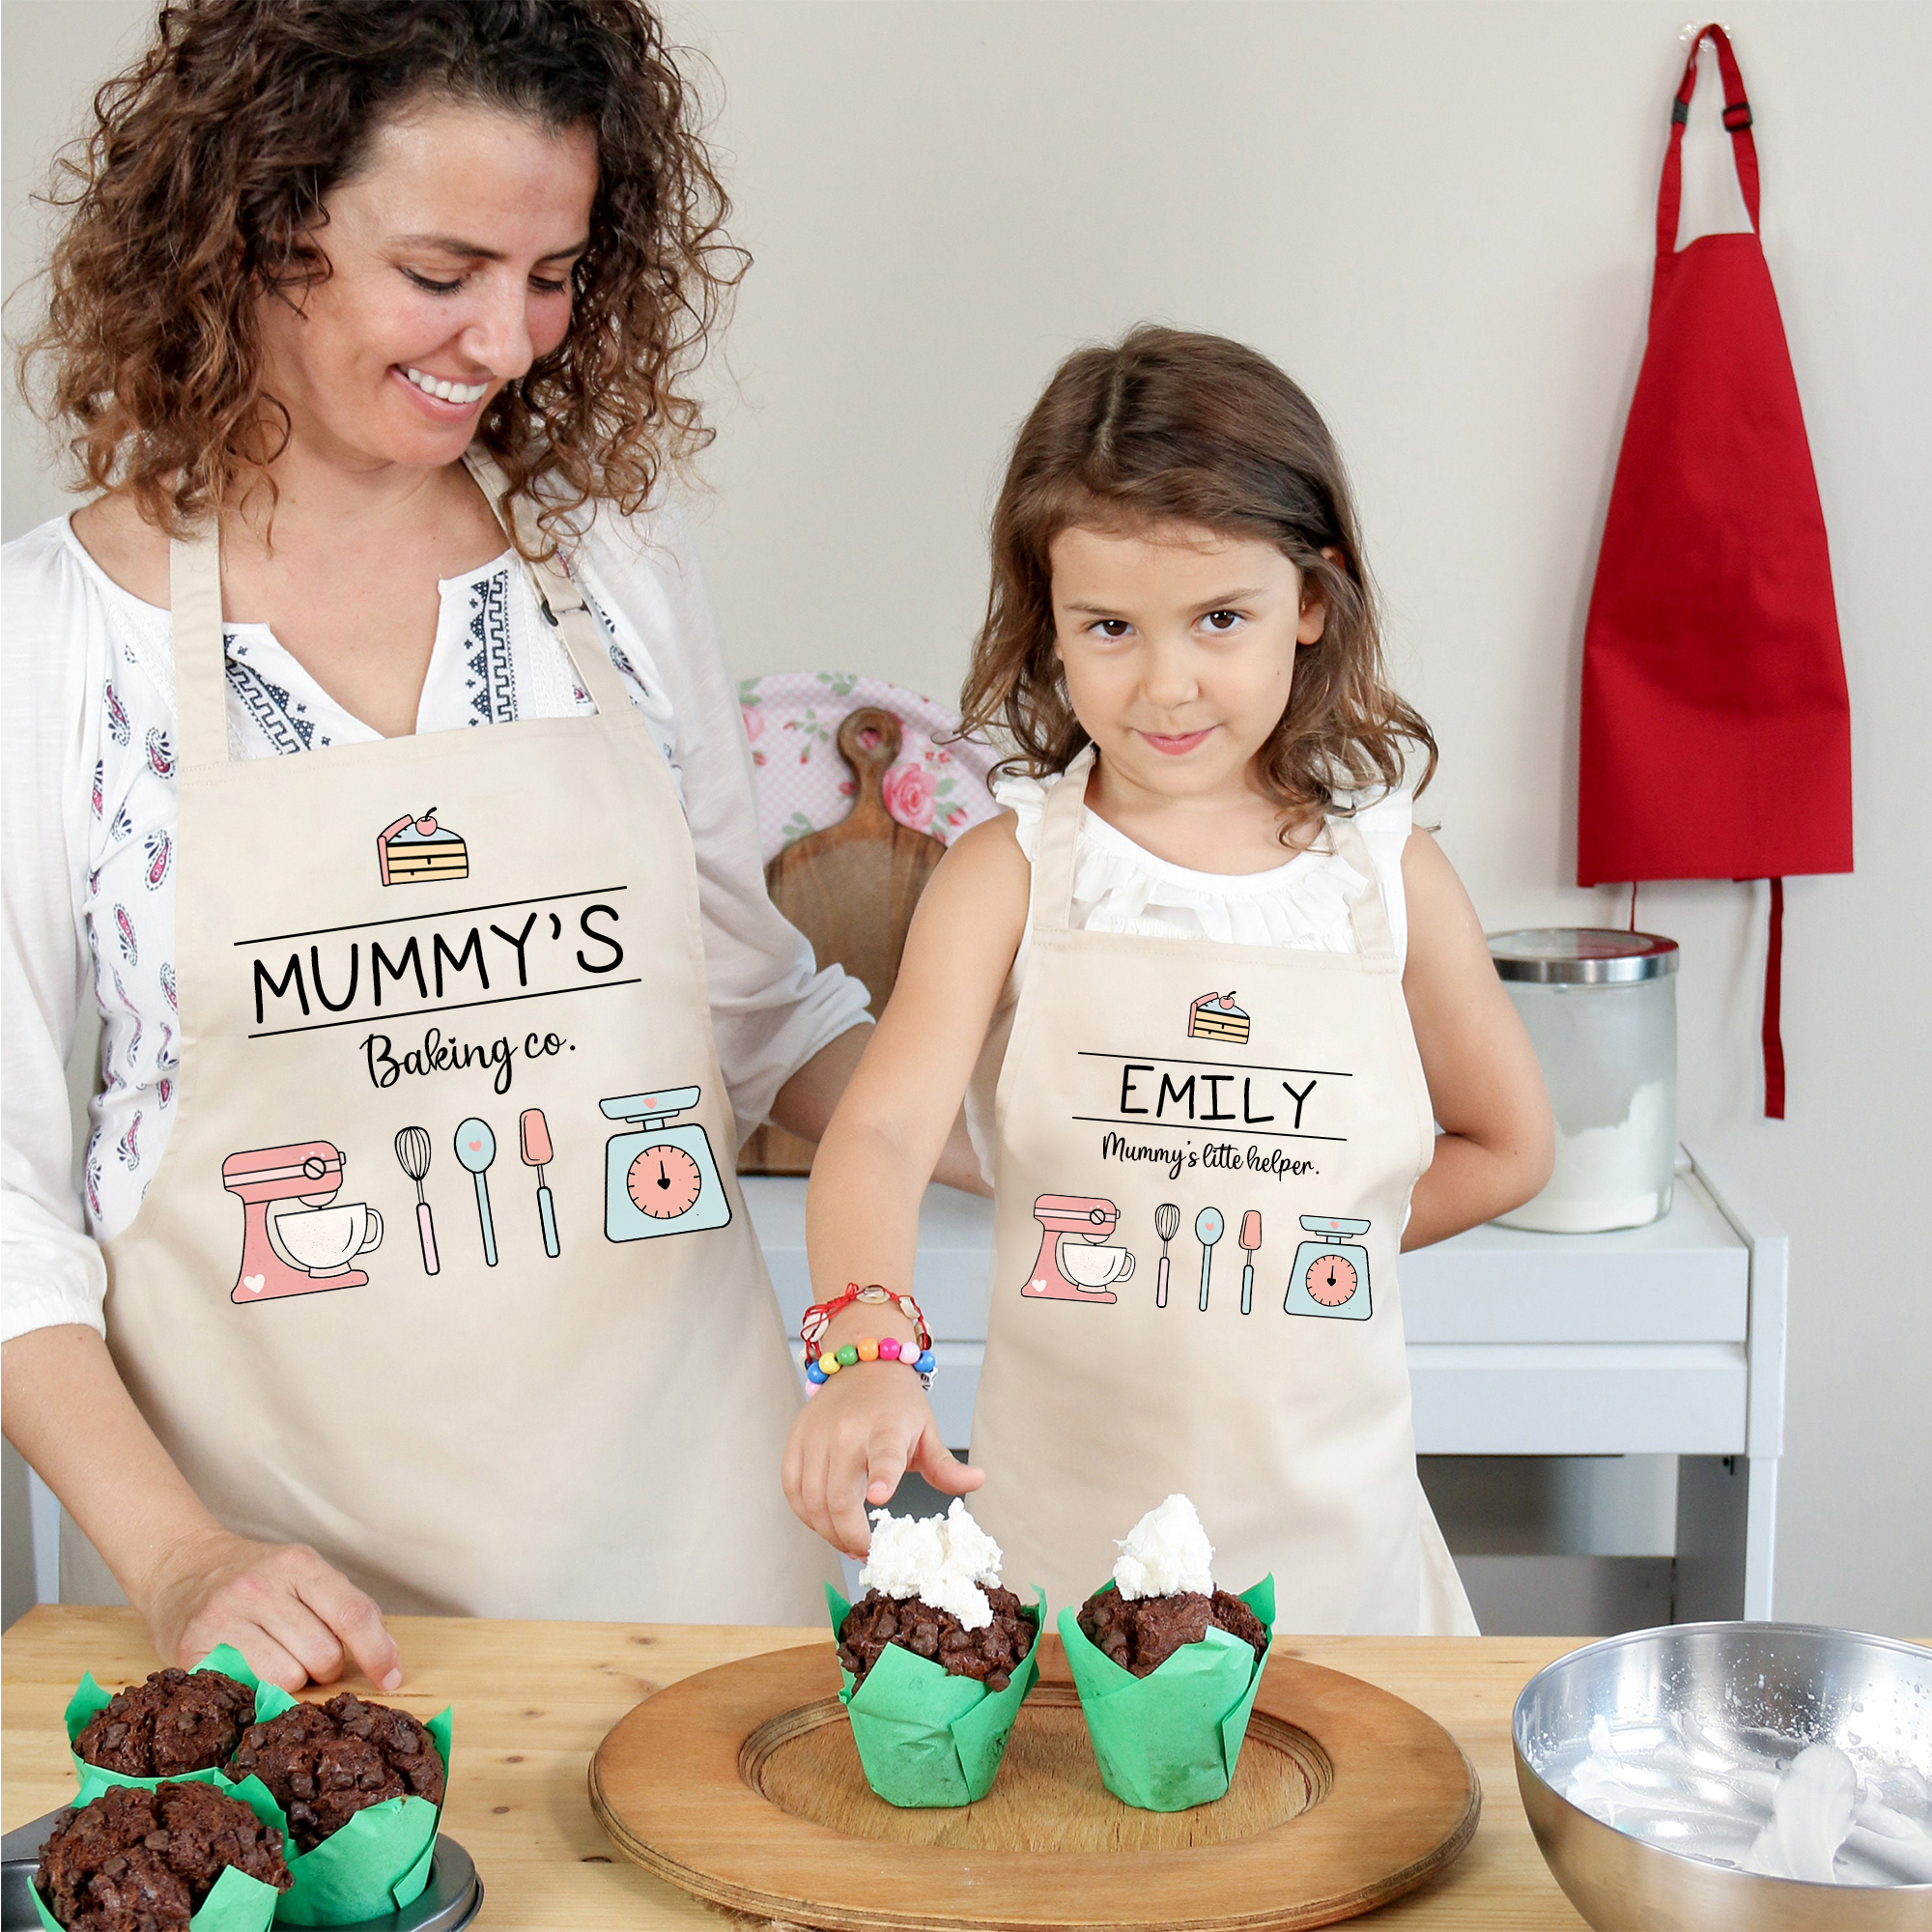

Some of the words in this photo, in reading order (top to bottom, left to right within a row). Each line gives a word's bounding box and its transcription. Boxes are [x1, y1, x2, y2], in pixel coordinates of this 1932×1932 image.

[253, 904, 624, 1025] MUMMY'S
[358, 1027, 519, 1095] Baking
[524, 1032, 577, 1060] co.
[1120, 1064, 1318, 1129] EMILY
[1102, 1131, 1201, 1180] Mummy's
[1246, 1145, 1320, 1182] helper.
